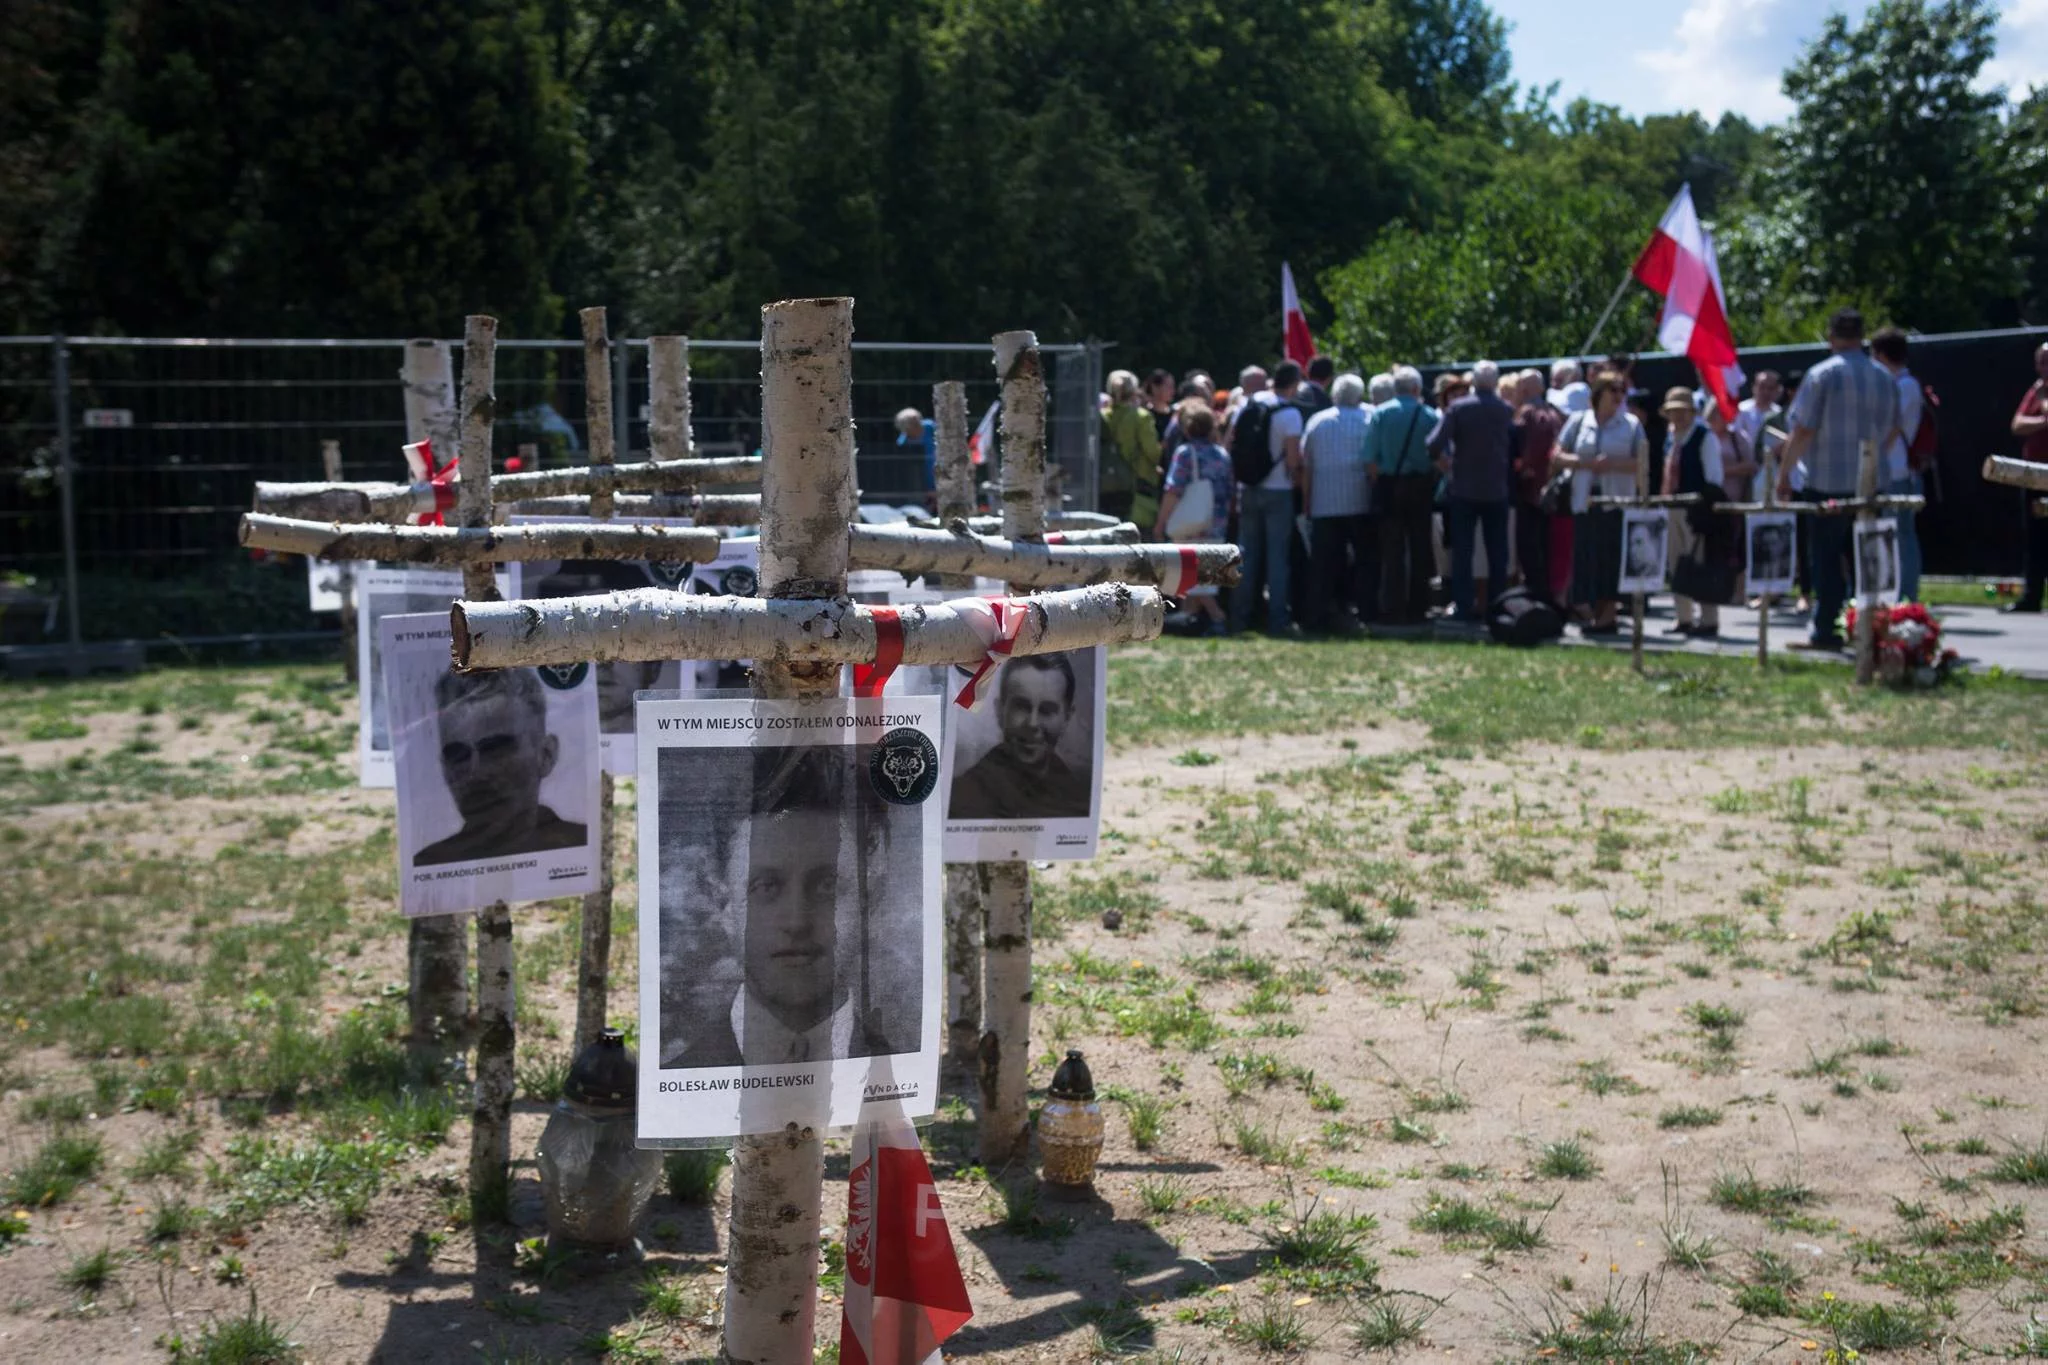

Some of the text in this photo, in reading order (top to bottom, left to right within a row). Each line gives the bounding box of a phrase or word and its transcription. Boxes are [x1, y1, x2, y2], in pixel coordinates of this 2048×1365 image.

[657, 714, 922, 730] W TYM MIEJSCU ZOSTAŁEM ODNALEZIONY
[436, 866, 485, 880] ARKADIUSZ
[486, 859, 537, 873] WASILEWSKI
[658, 1074, 815, 1093] BOLESŁAW BUDELEWSKI
